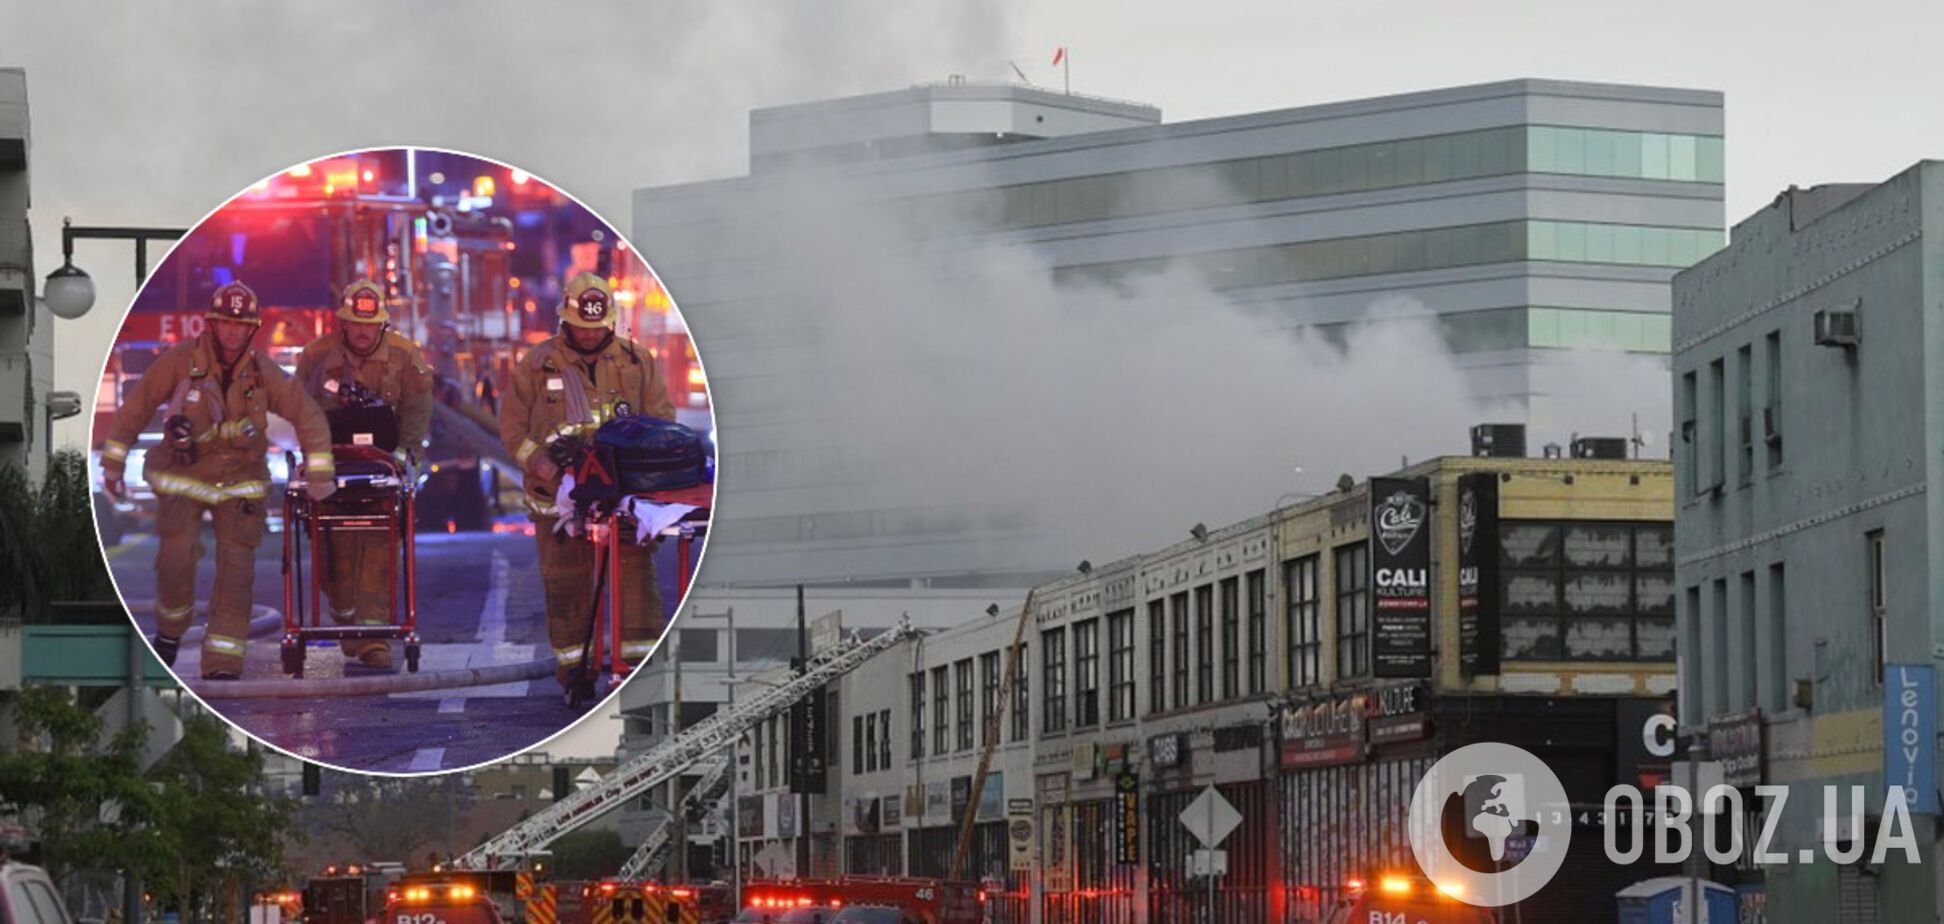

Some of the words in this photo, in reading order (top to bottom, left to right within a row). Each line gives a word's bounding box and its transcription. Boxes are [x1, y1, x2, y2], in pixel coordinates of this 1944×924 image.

[231, 296, 243, 308] 15
[584, 302, 603, 315] 46
[181, 314, 205, 338] 10
[1376, 568, 1426, 587] CALI
[1126, 793, 1136, 862] VAPE
[915, 888, 934, 901] 46
